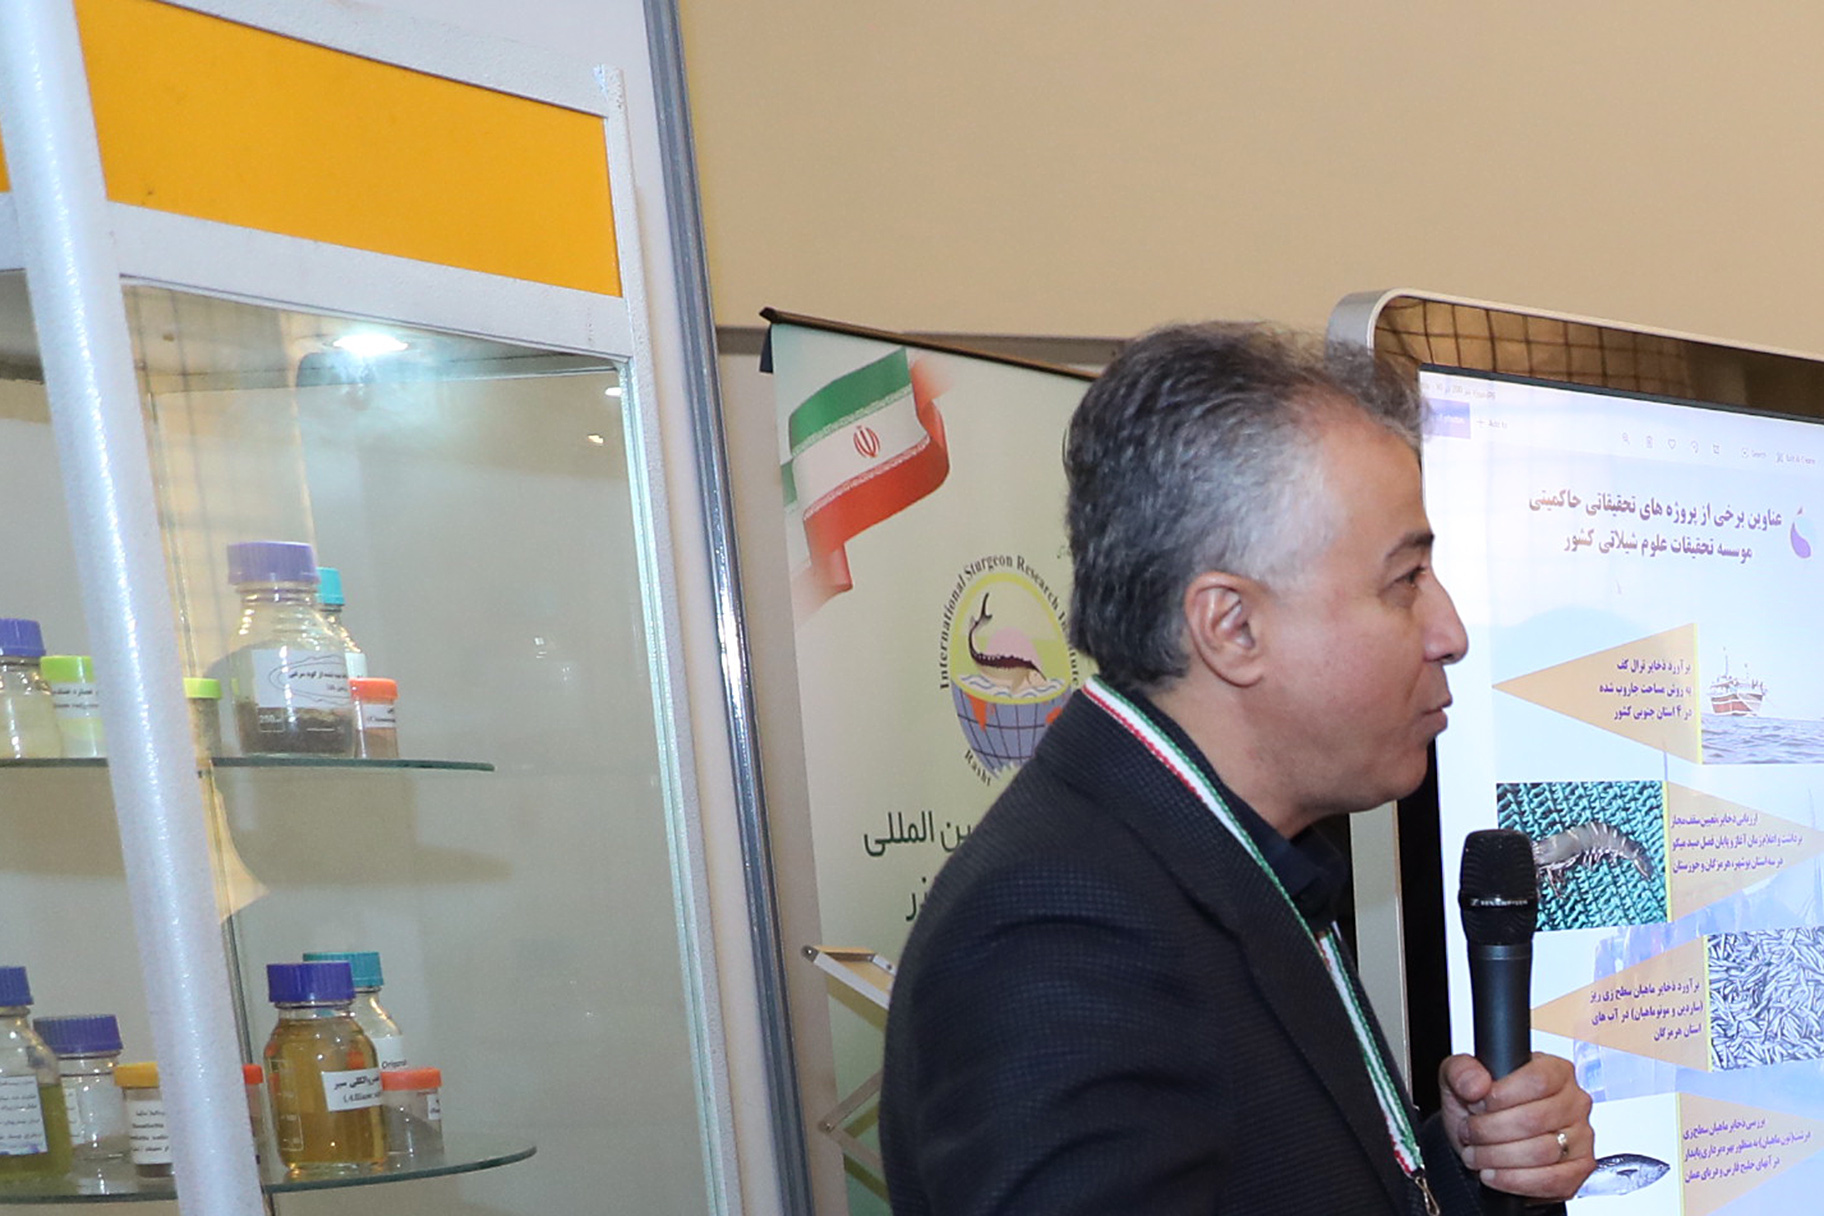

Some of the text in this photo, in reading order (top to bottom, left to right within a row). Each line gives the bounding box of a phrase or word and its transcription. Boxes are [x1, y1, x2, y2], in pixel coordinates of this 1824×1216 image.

[1529, 489, 1783, 531] عناوین برخی از پروژه های تحقیقاتی حاکمیتی
[1563, 528, 1753, 564] موسسه تحقیقات علوم شیلاتی کشور
[940, 574, 967, 690] International
[964, 554, 1014, 582] Sturgeon
[1017, 555, 1058, 610] Research
[1599, 682, 1614, 692] شده
[1614, 705, 1632, 720] کشور
[864, 811, 935, 857] المللی
[1653, 1027, 1683, 1041] هرمزگان
